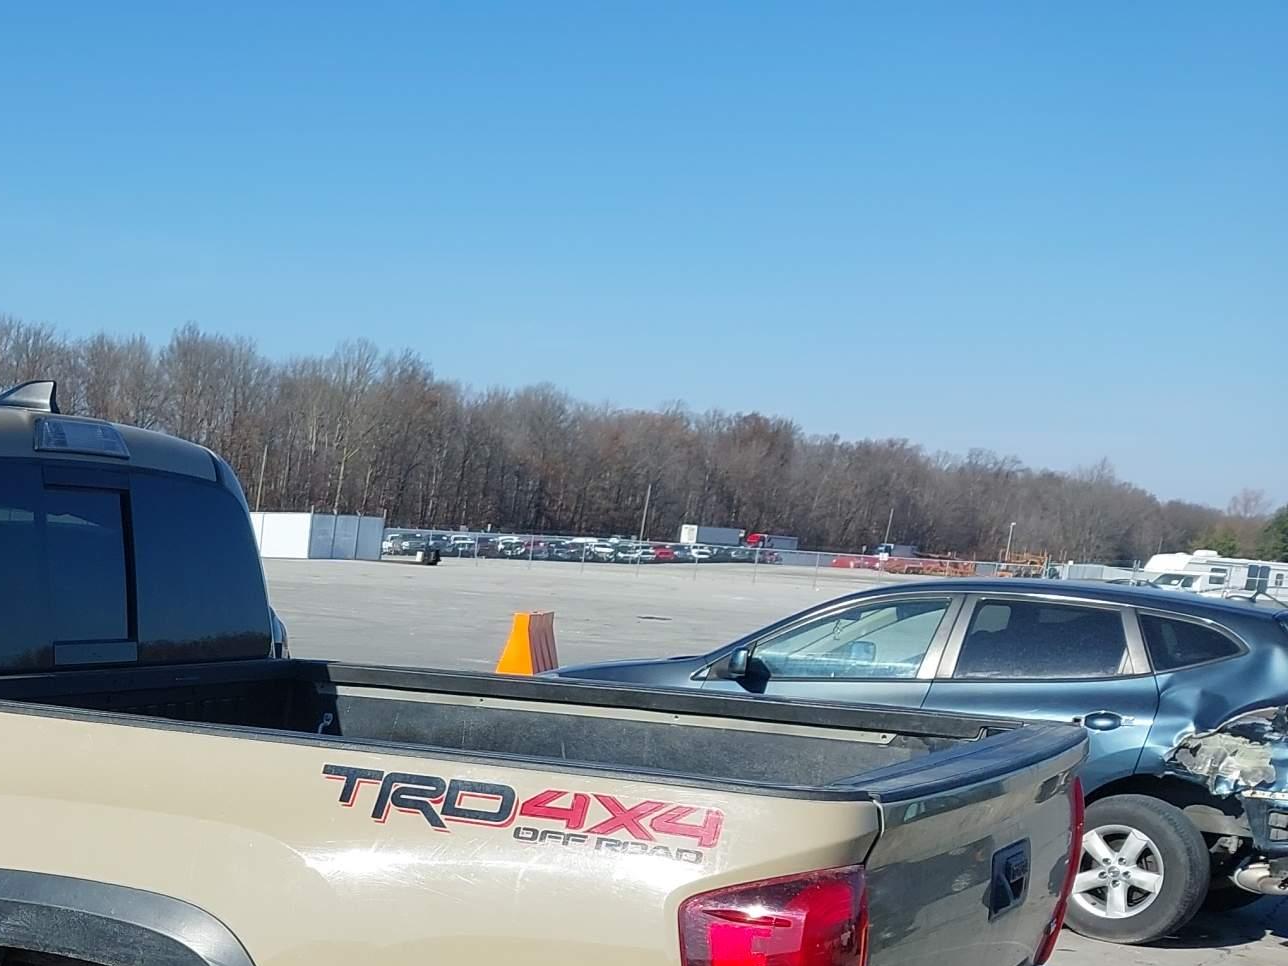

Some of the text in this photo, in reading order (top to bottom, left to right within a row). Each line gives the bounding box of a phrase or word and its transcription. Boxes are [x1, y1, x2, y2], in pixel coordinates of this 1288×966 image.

[322, 764, 726, 849] TRD 4X4
[513, 827, 704, 865] OFF ROAD
